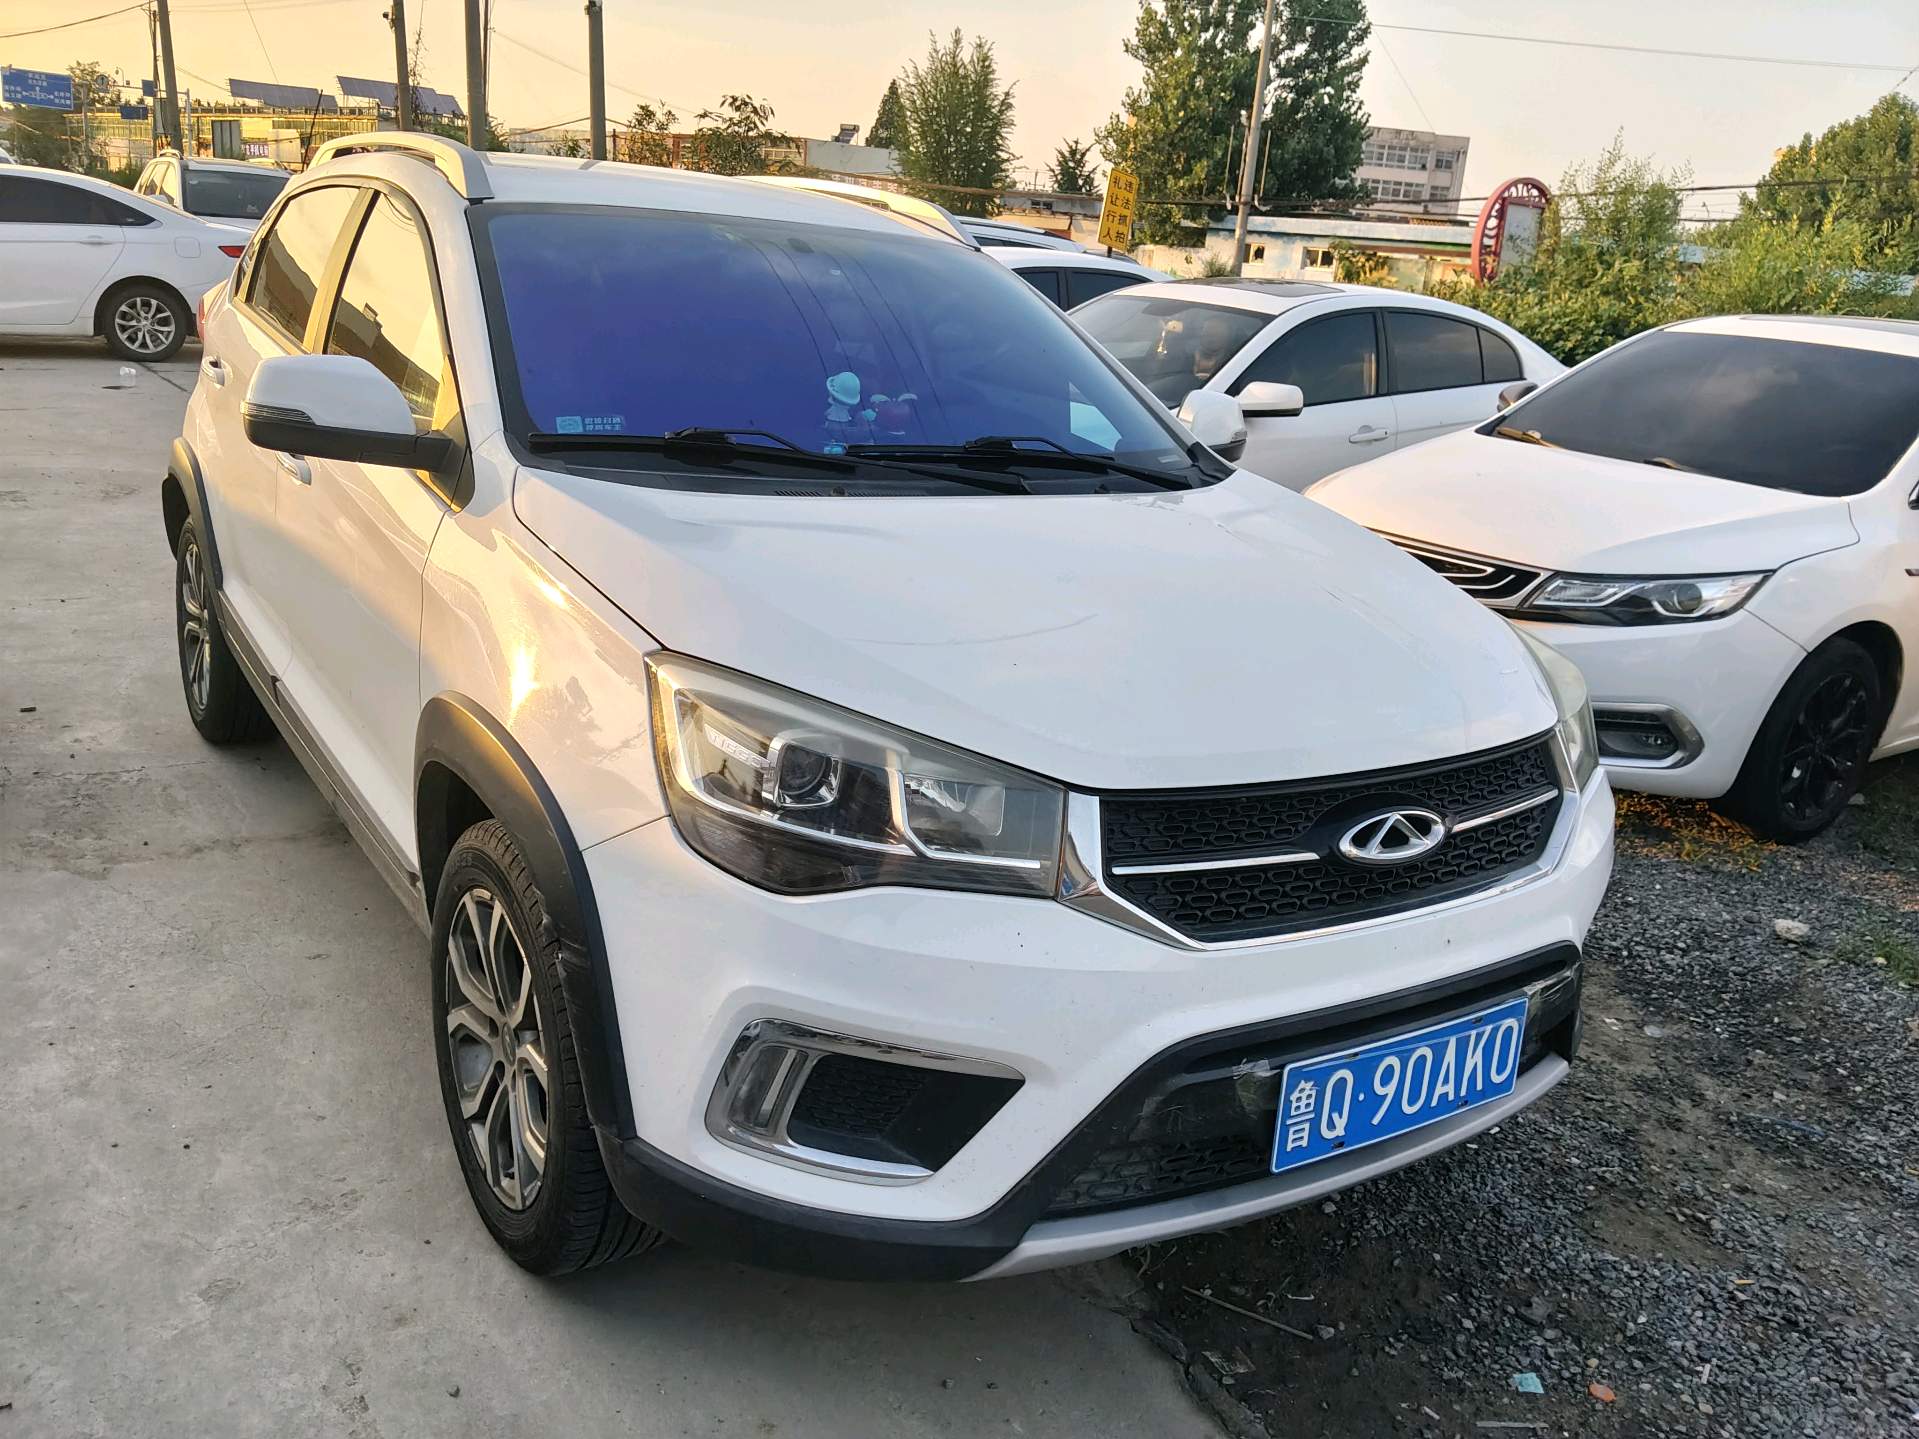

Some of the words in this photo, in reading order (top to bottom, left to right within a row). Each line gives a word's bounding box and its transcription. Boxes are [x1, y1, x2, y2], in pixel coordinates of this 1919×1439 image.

[1102, 175, 1122, 241] 礼让行人
[1115, 178, 1135, 243] 违法抓拍
